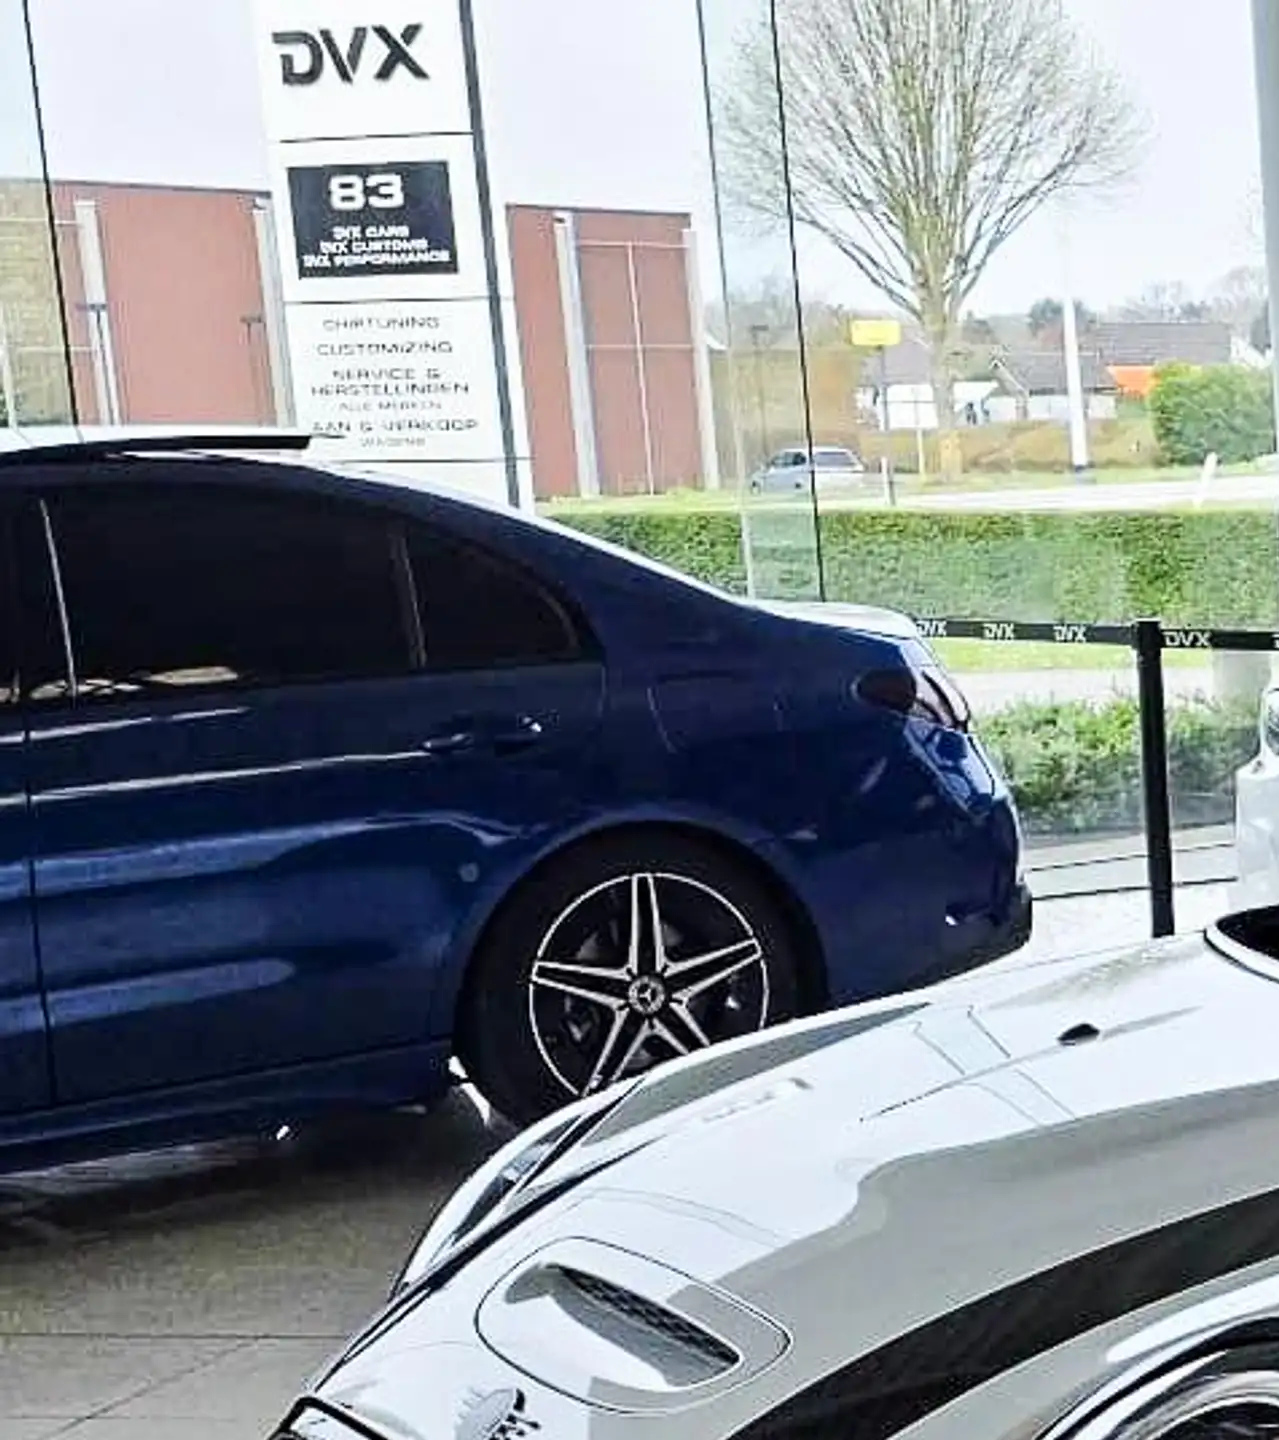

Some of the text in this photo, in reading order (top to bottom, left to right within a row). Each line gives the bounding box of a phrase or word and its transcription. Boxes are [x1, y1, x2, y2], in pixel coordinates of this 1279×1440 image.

[272, 23, 430, 86] DVX
[329, 174, 404, 211] 83
[316, 341, 454, 356] CUSTOMIZING
[983, 622, 1015, 641] DVX
[1053, 624, 1087, 643] DVX
[1162, 630, 1212, 647] DVX
